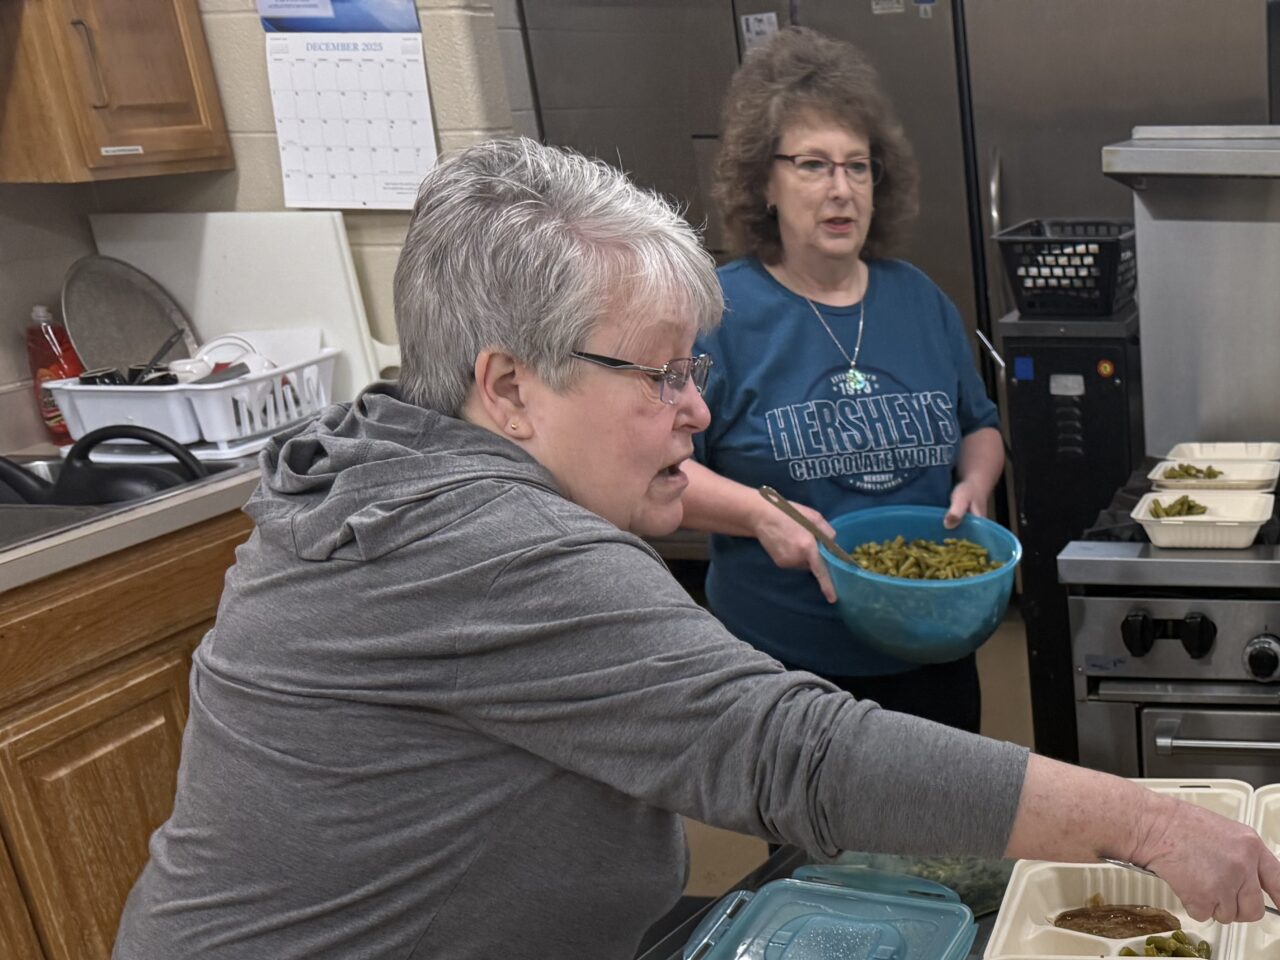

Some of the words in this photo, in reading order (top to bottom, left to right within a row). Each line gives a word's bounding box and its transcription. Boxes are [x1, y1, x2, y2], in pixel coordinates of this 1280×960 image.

[306, 42, 359, 52] DECEMBER
[362, 42, 383, 52] 2025
[765, 391, 960, 462] HERSHEY'S
[789, 450, 895, 482] CHOCOLATE
